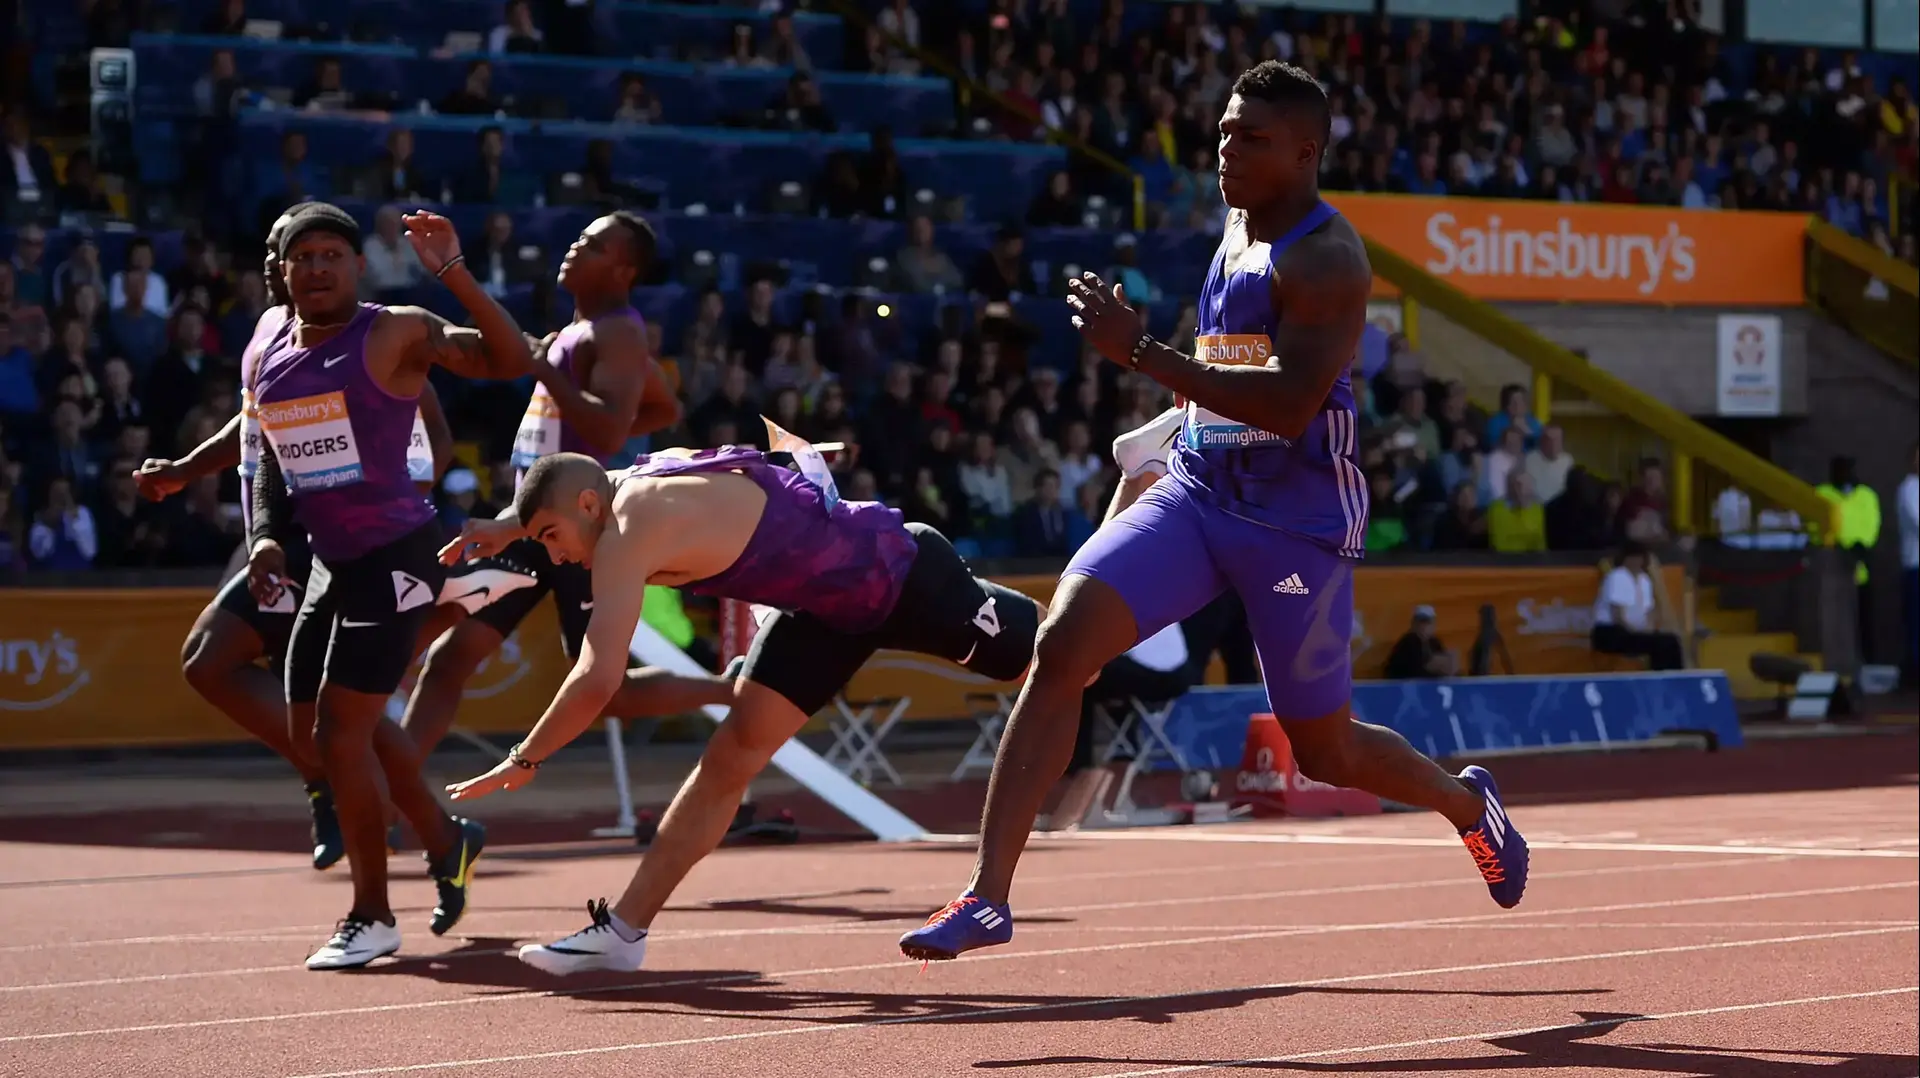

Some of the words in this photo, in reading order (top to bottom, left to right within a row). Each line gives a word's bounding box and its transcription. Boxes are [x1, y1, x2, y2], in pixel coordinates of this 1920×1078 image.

[1426, 212, 1696, 294] Sainsbury's
[1196, 339, 1268, 364] nsbury's
[261, 398, 342, 424] Sainsbury's
[400, 576, 419, 602] 7
[1273, 585, 1309, 595] adidas
[1432, 685, 1453, 710] 7
[1583, 682, 1602, 707] 6
[1701, 678, 1718, 704] 5
